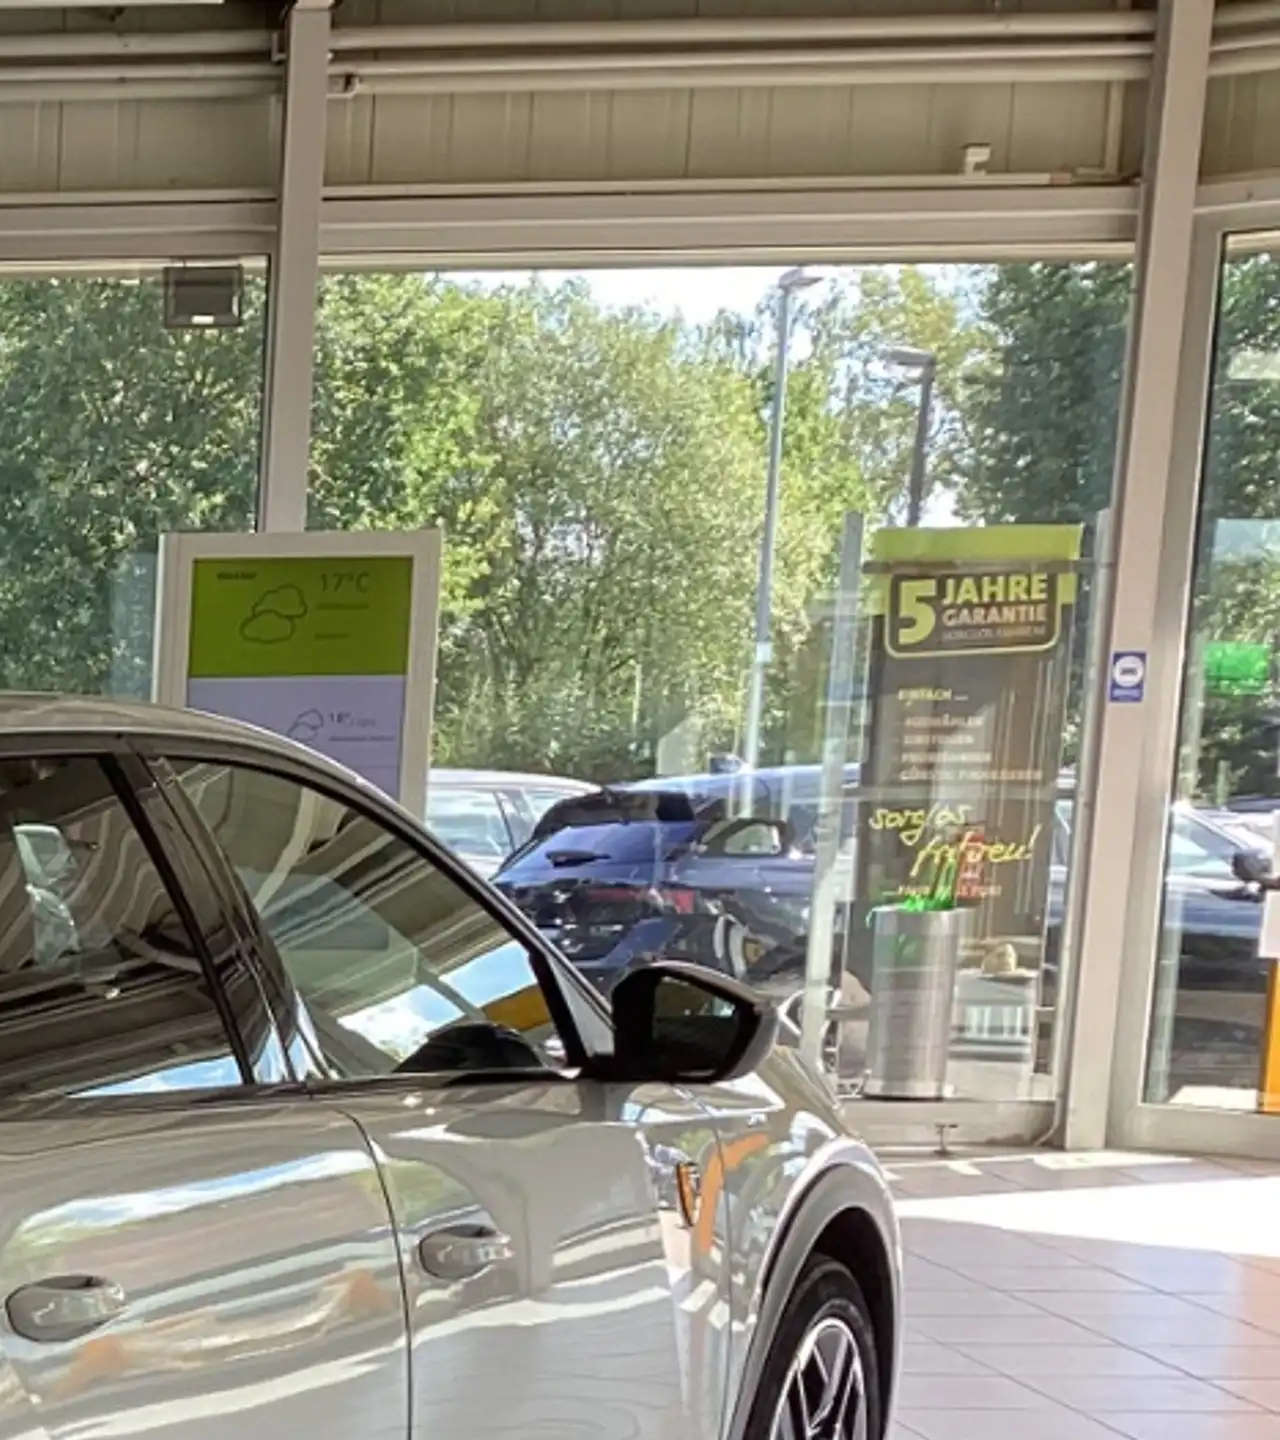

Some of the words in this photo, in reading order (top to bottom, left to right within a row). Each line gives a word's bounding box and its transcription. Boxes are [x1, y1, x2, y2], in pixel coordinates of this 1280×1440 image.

[320, 572, 370, 593] 17°C
[898, 578, 937, 645] 5
[942, 573, 1049, 605] JAHRE
[942, 603, 1048, 627] GARANTIE
[868, 801, 973, 846] sorglos
